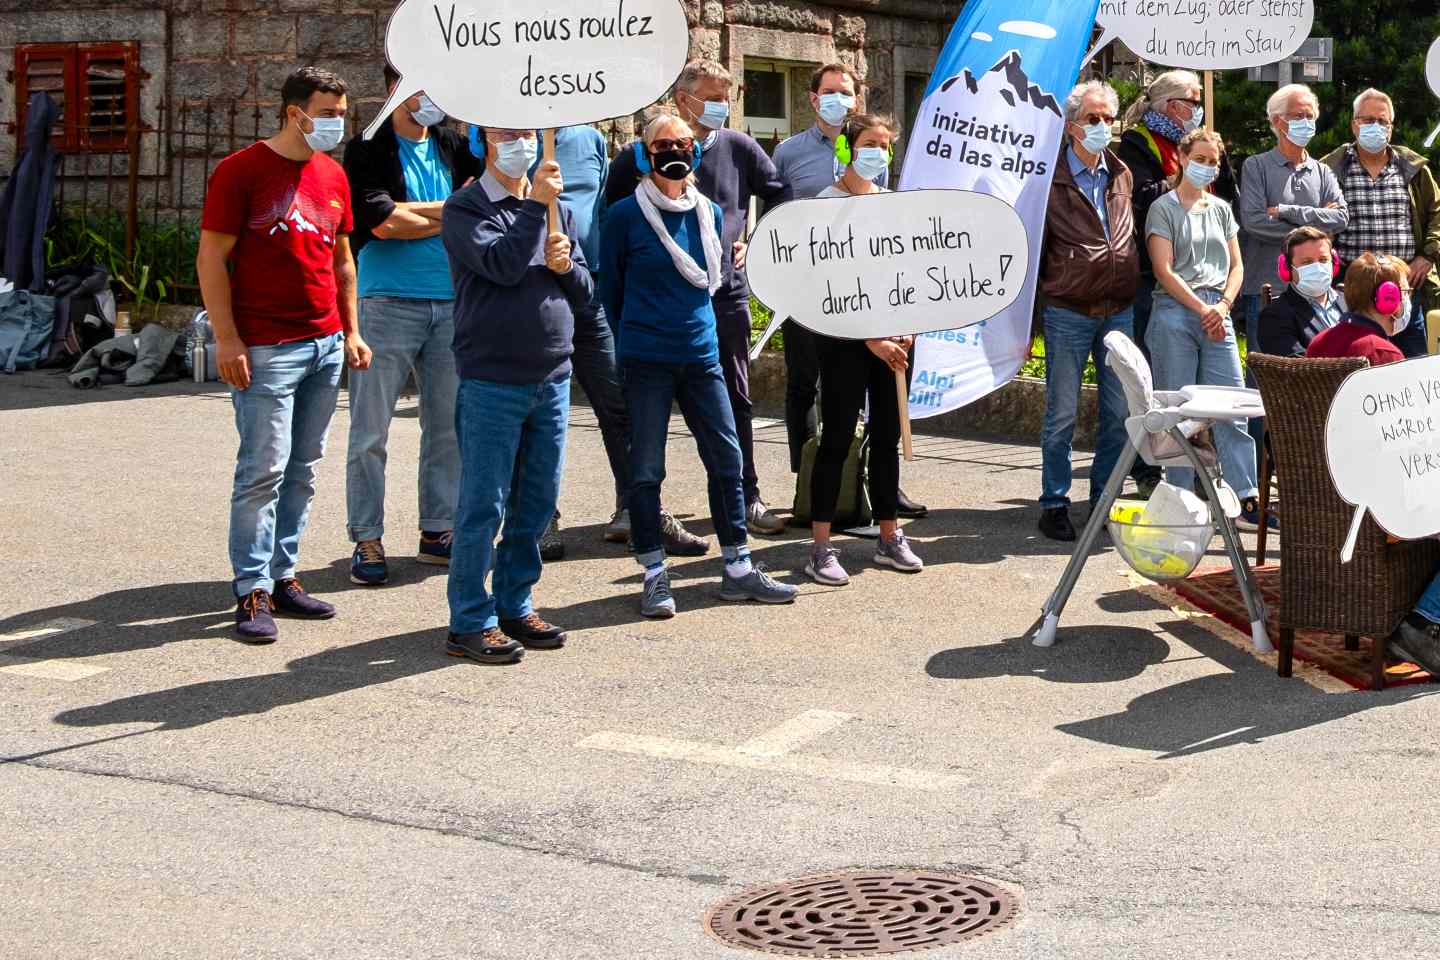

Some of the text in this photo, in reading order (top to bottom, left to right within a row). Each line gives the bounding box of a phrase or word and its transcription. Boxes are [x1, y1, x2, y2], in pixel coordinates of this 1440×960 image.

[433, 2, 501, 52] Vous
[515, 16, 571, 44] nous
[1145, 27, 1168, 56] du
[1176, 29, 1215, 58] noch
[1221, 27, 1241, 57] im
[519, 54, 606, 97] dessus
[931, 106, 1035, 149] iniziativa
[926, 133, 1047, 180] da las alps
[769, 216, 971, 266] Ihr fahrt uns mitten
[822, 254, 1013, 315] durch die Stube!
[915, 369, 956, 389] Alpi
